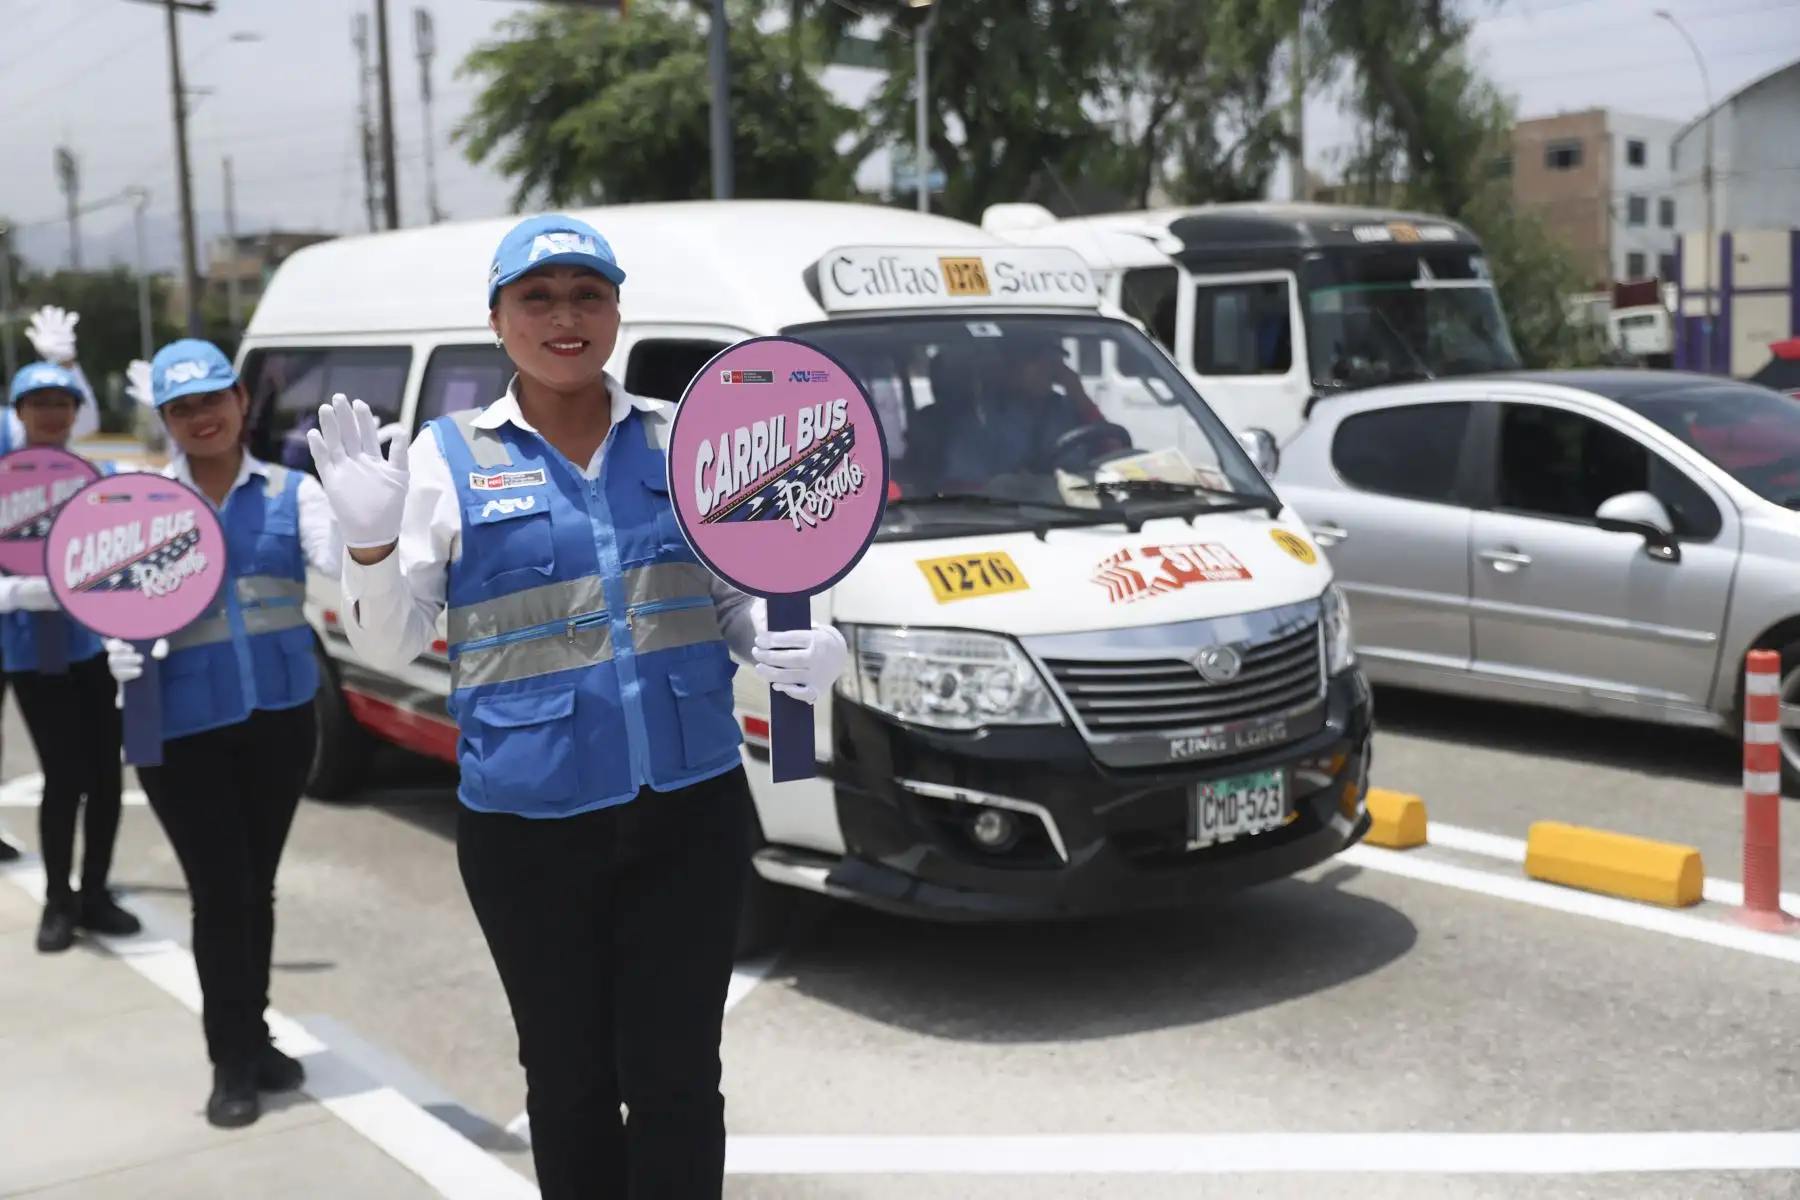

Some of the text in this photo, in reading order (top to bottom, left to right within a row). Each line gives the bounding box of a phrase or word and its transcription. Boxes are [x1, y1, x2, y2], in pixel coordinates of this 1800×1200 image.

[832, 256, 939, 296] Callao
[994, 262, 1087, 293] Surco
[695, 398, 849, 517] CARRIL BUS
[783, 453, 867, 531] Rosado
[64, 509, 196, 590] CARRIL BUS
[931, 556, 1016, 594] 1276
[1170, 721, 1288, 759] KING LONG
